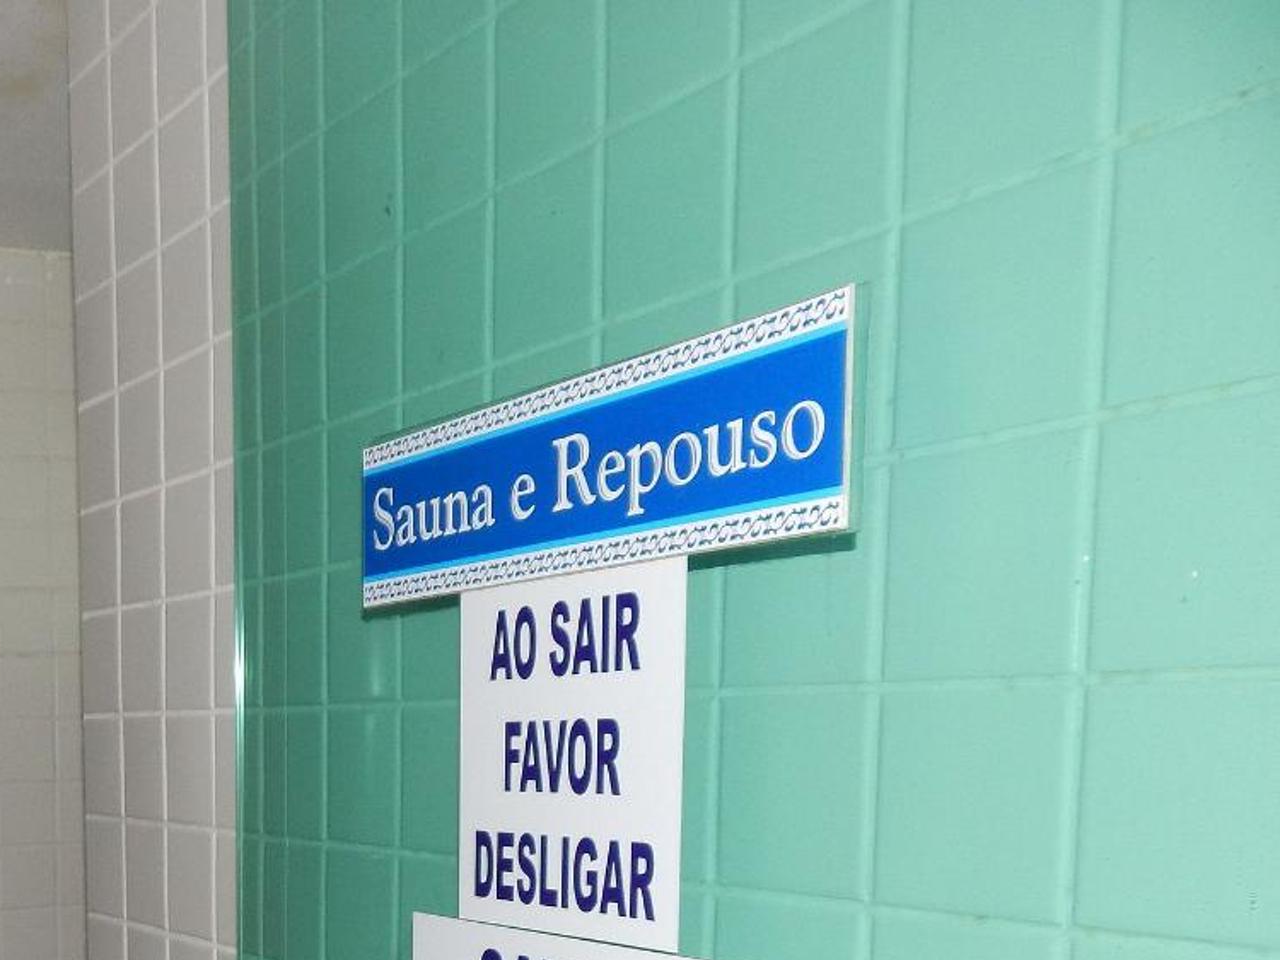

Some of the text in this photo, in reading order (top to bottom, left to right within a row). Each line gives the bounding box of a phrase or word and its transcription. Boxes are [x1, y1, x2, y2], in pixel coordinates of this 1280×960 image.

[372, 399, 825, 550] Sauna e Repouso
[490, 592, 640, 680] AO SAIR
[504, 718, 620, 795] FAVOR
[474, 830, 655, 921] DESLIGAR
